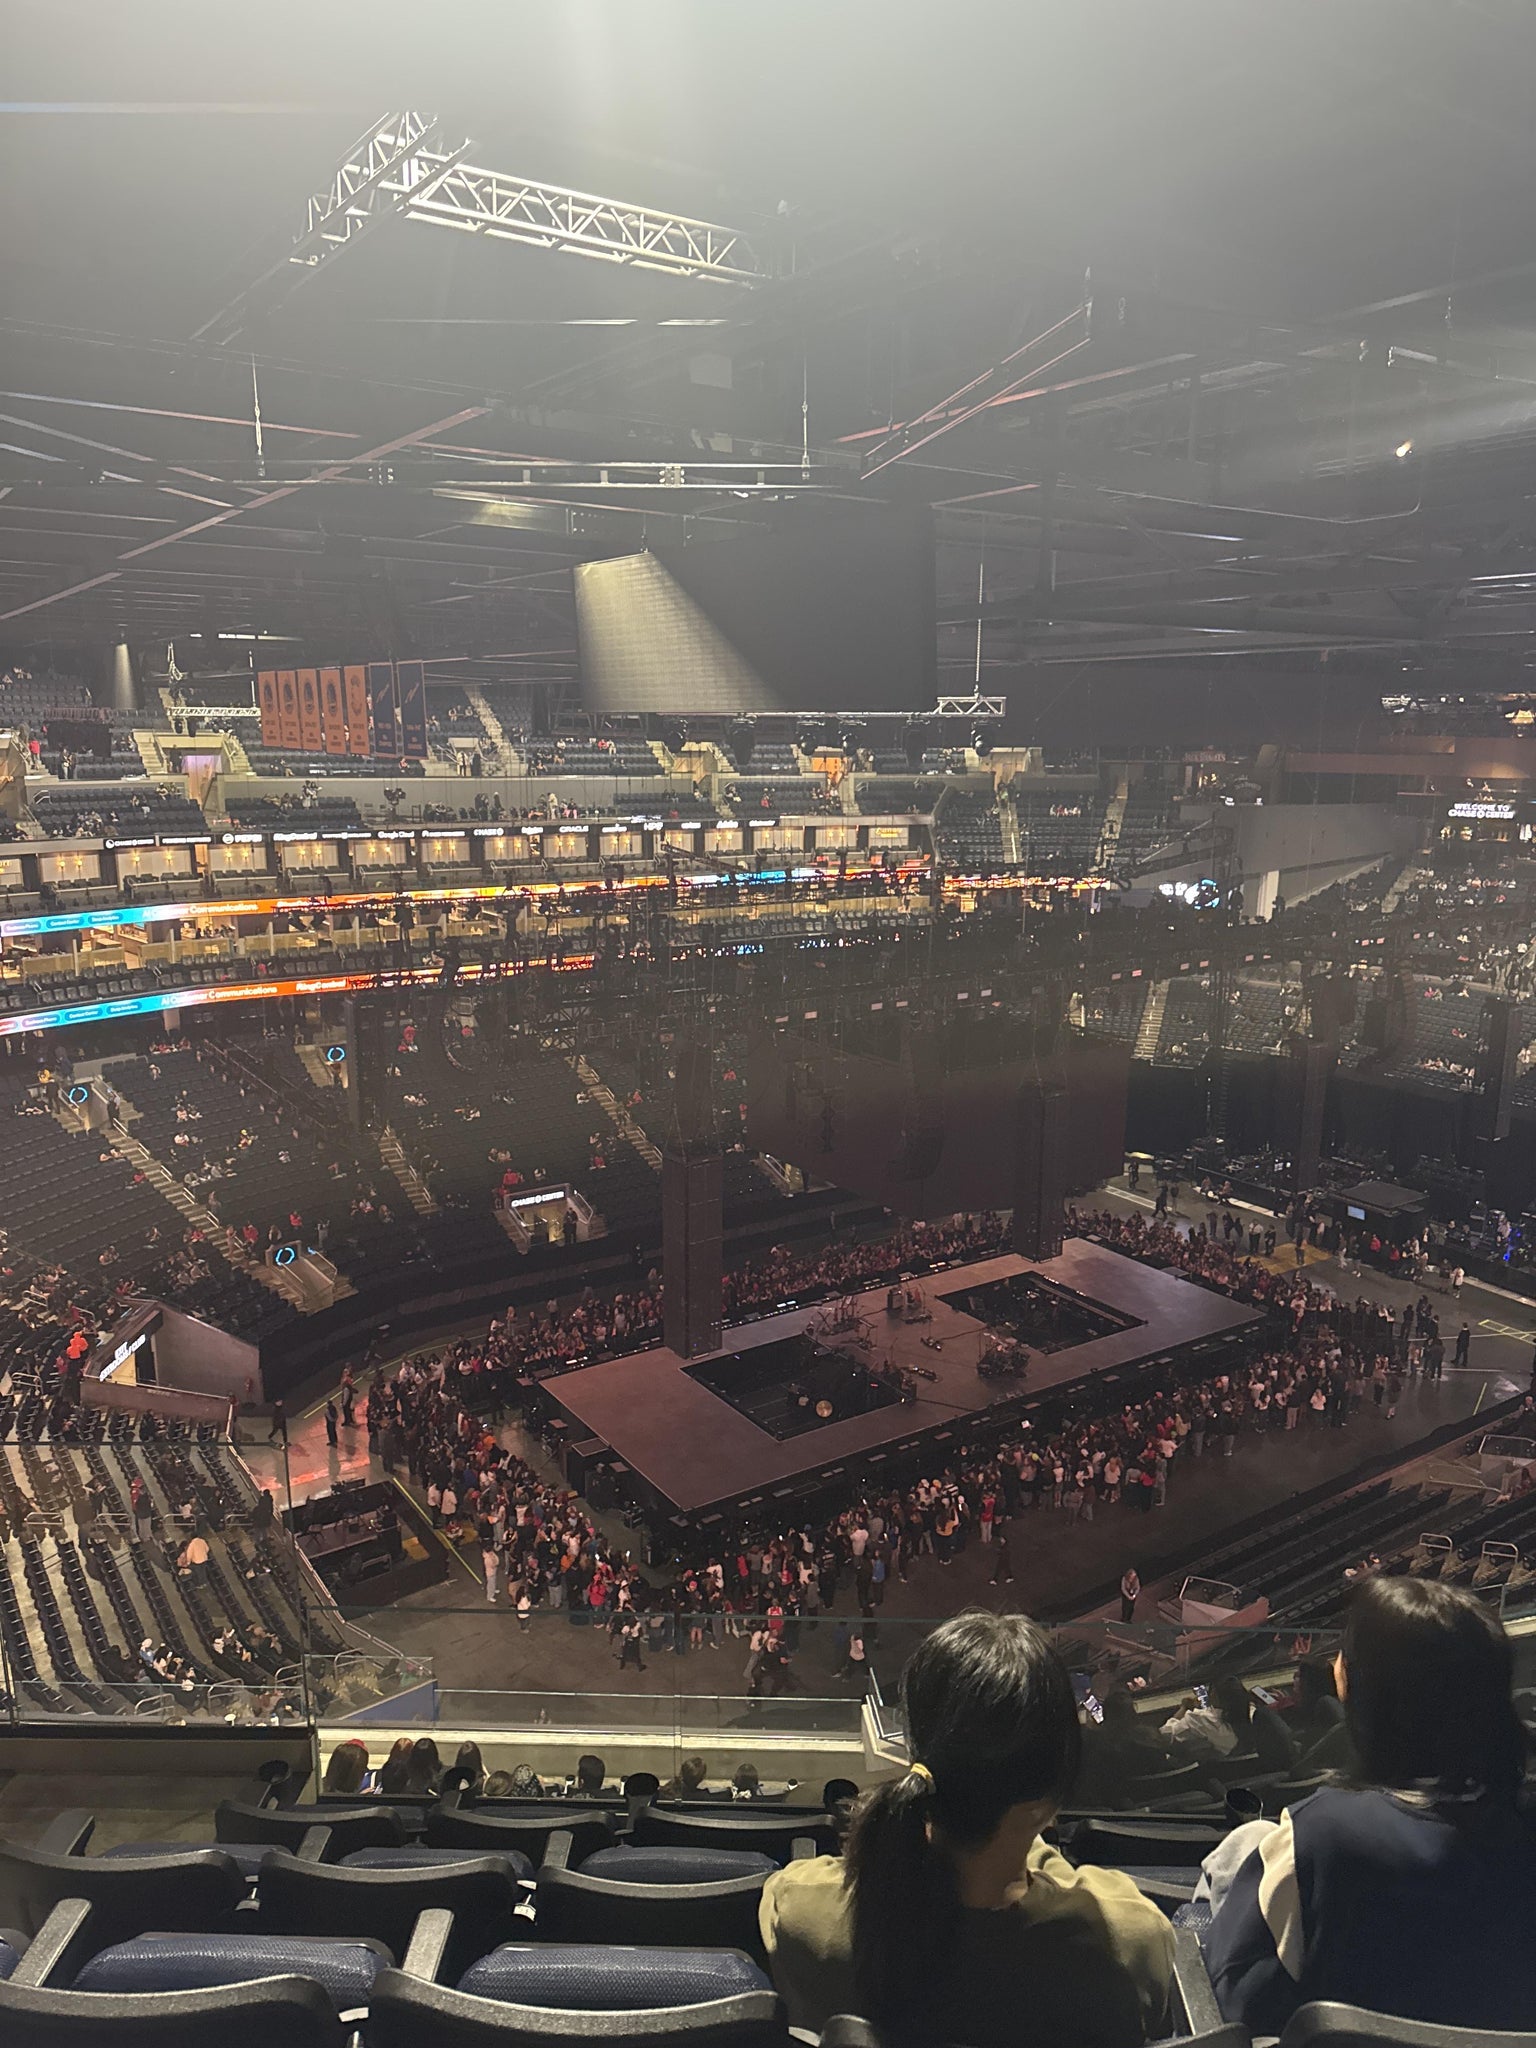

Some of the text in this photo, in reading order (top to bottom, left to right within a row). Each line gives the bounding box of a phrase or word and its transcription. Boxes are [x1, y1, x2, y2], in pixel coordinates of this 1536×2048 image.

[1454, 803, 1495, 811] WELCOME
[1448, 809, 1514, 819] CHASE CENTER
[190, 904, 259, 914] Communications
[208, 986, 277, 999] Communications
[295, 980, 346, 992] RingCentral
